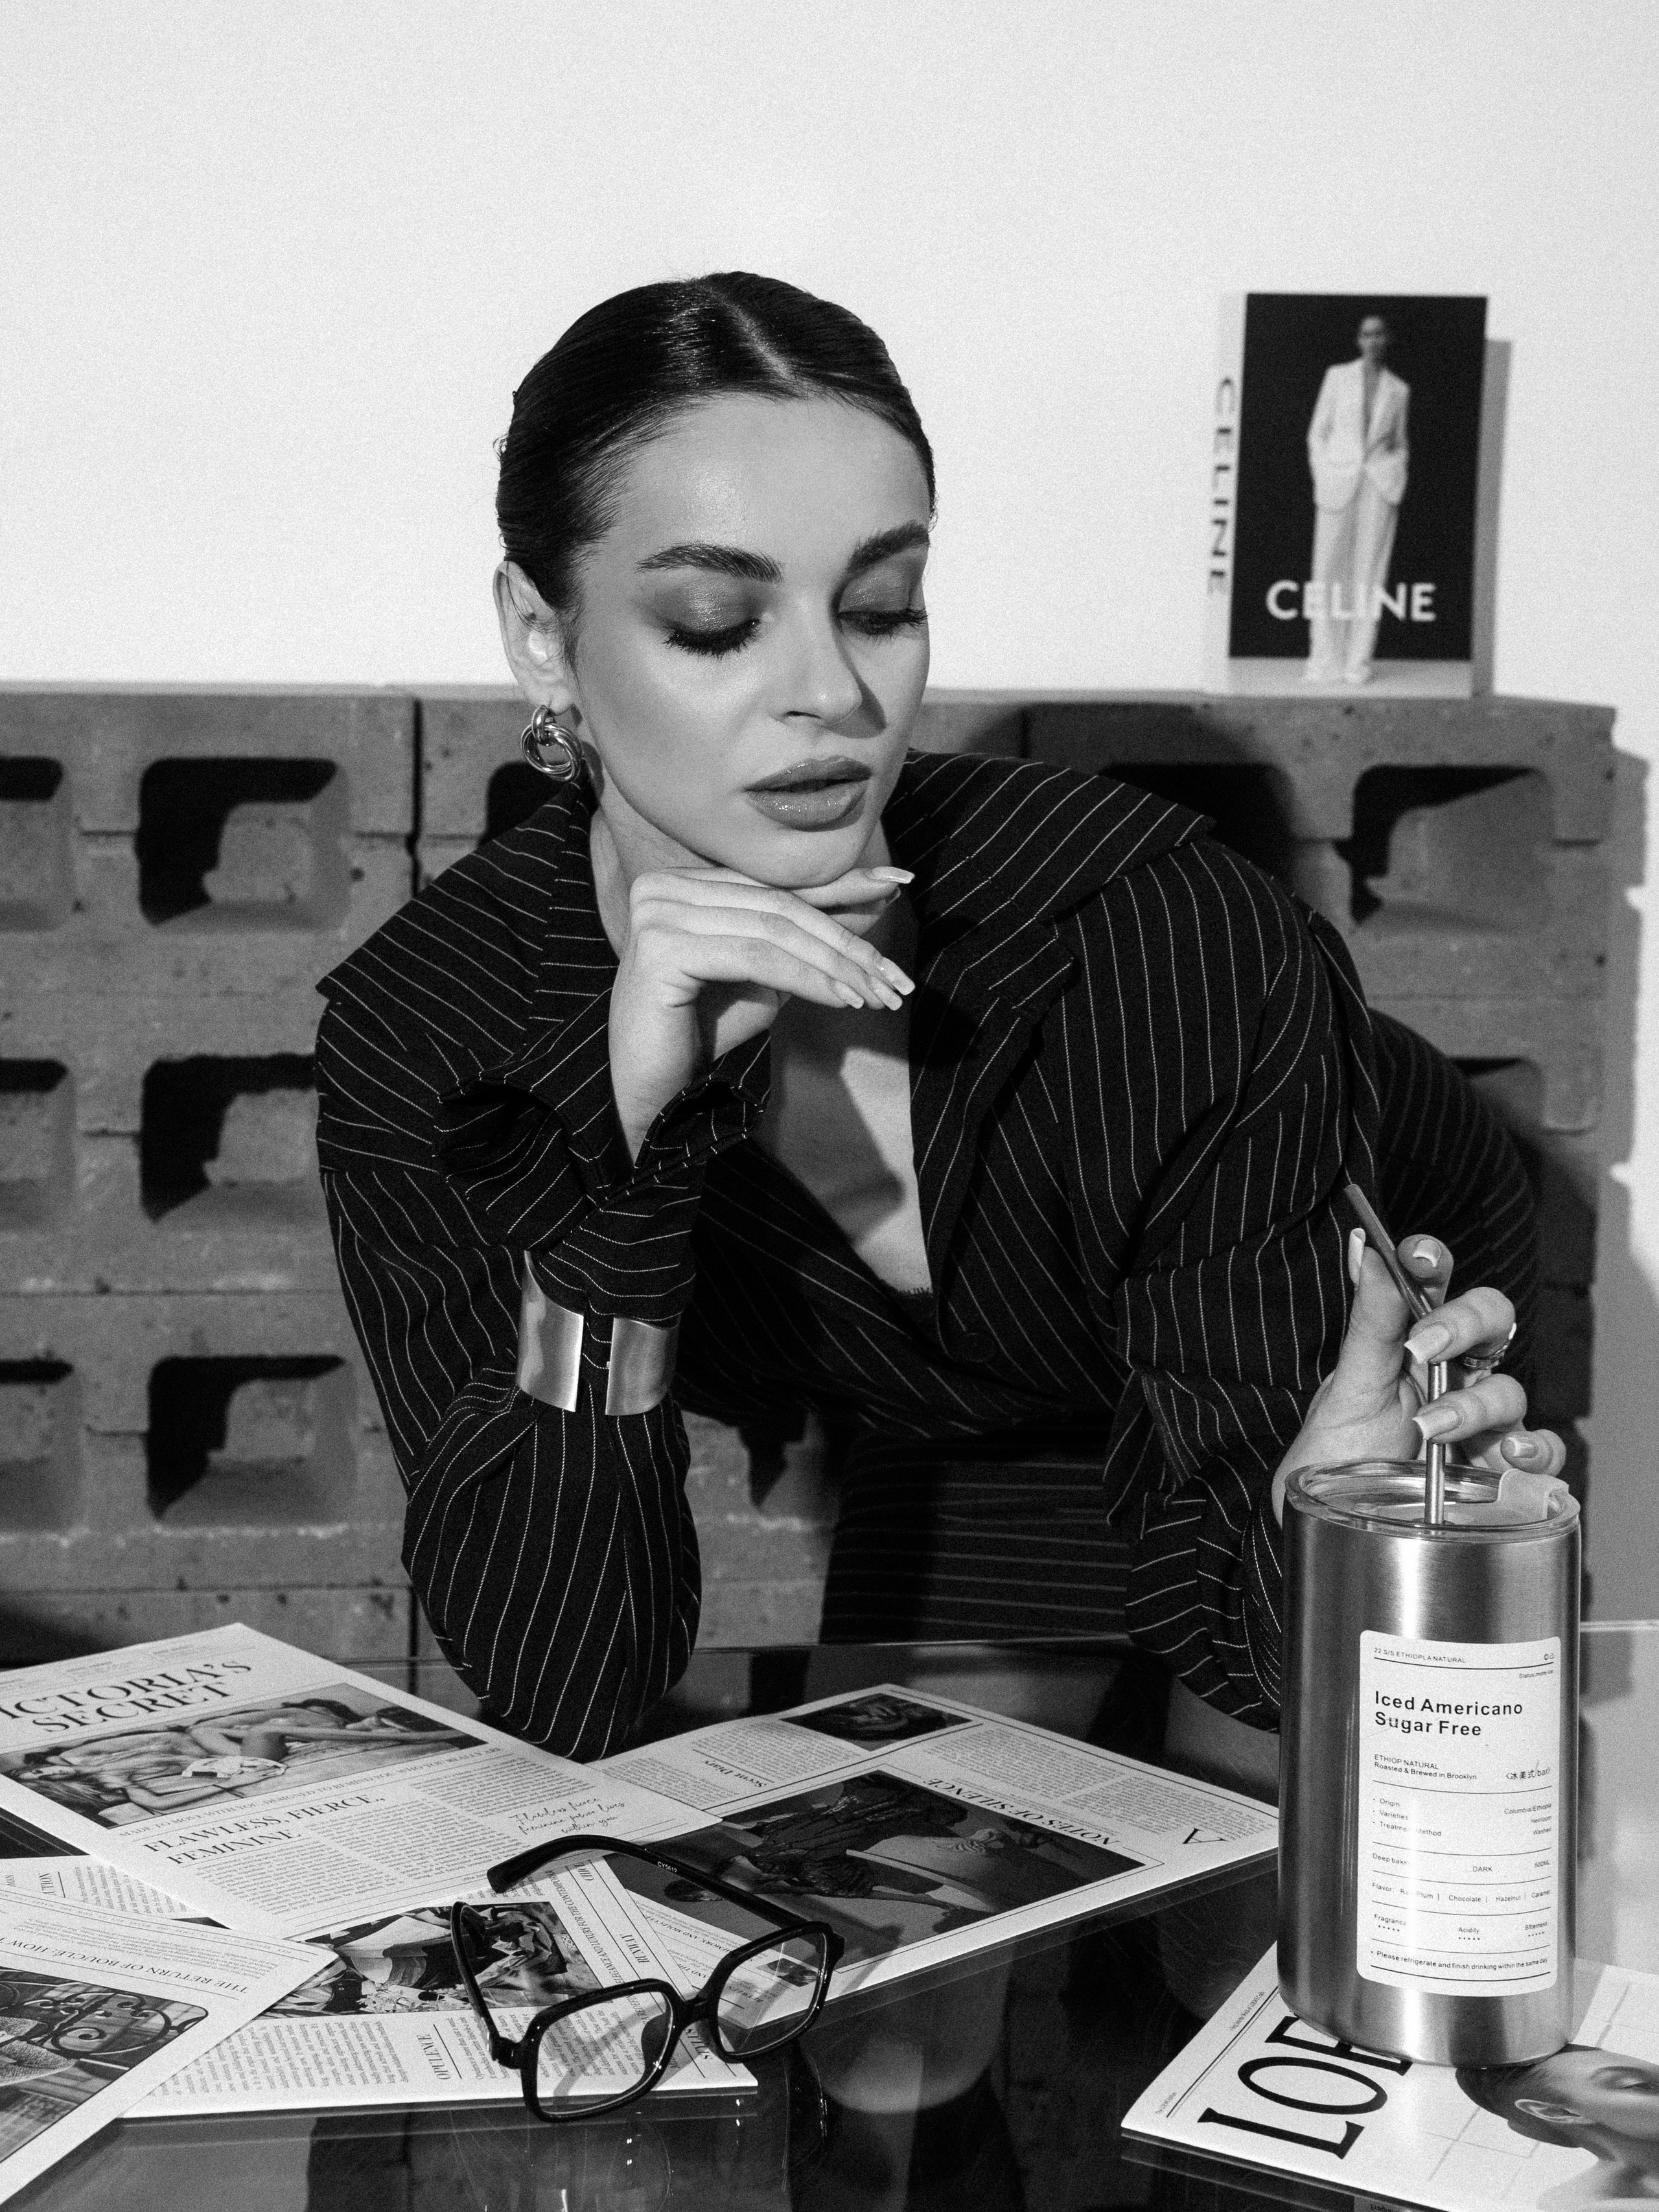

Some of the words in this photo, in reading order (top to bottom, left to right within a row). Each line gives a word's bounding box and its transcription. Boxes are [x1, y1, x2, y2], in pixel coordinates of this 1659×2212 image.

[32, 1682, 231, 1732] SECRET
[1375, 1690, 1415, 1710] Iced
[1421, 1698, 1523, 1716] Americano
[1375, 1711, 1433, 1734] Sugar
[1439, 1720, 1482, 1736] Free
[1374, 1762, 1402, 1773] Roasted
[1410, 1768, 1437, 1778] Brewed
[1446, 1772, 1478, 1781] Brooklyn
[1404, 1760, 1439, 1770] NATURAL
[923, 1777, 1009, 1810] SILENCE
[1380, 1798, 1400, 1807] Origin
[1012, 1806, 1043, 1821] OF
[1379, 1810, 1409, 1821] Varieties
[143, 1811, 290, 1853] FLAWLESS,
[1048, 1819, 1120, 1846] NOTES
[1181, 1827, 1229, 1845] A
[167, 1828, 302, 1866] FEMININE
[1372, 1852, 1391, 1863] Deep
[1448, 1894, 1482, 1903] Chocolate
[567, 1903, 580, 1917] THE
[574, 1915, 587, 1927] FOR
[1374, 1914, 1408, 1926] Fragrance
[582, 1926, 600, 1947] LUXURY
[8, 1938, 48, 1954] HOW
[594, 1944, 608, 1957] AND
[621, 1934, 650, 1964] RUNWAY
[121, 1960, 146, 1972] OF
[599, 1953, 626, 1985] ELEGANCE
[1376, 1950, 1400, 1962] Please
[1400, 1957, 1437, 1968] refrigerate
[1452, 1962, 1471, 1970] finish
[1526, 1959, 1540, 1967] same
[146, 1964, 214, 1986] RETURN
[216, 1979, 248, 1994] THE
[417, 2034, 451, 2080] OPULENCE
